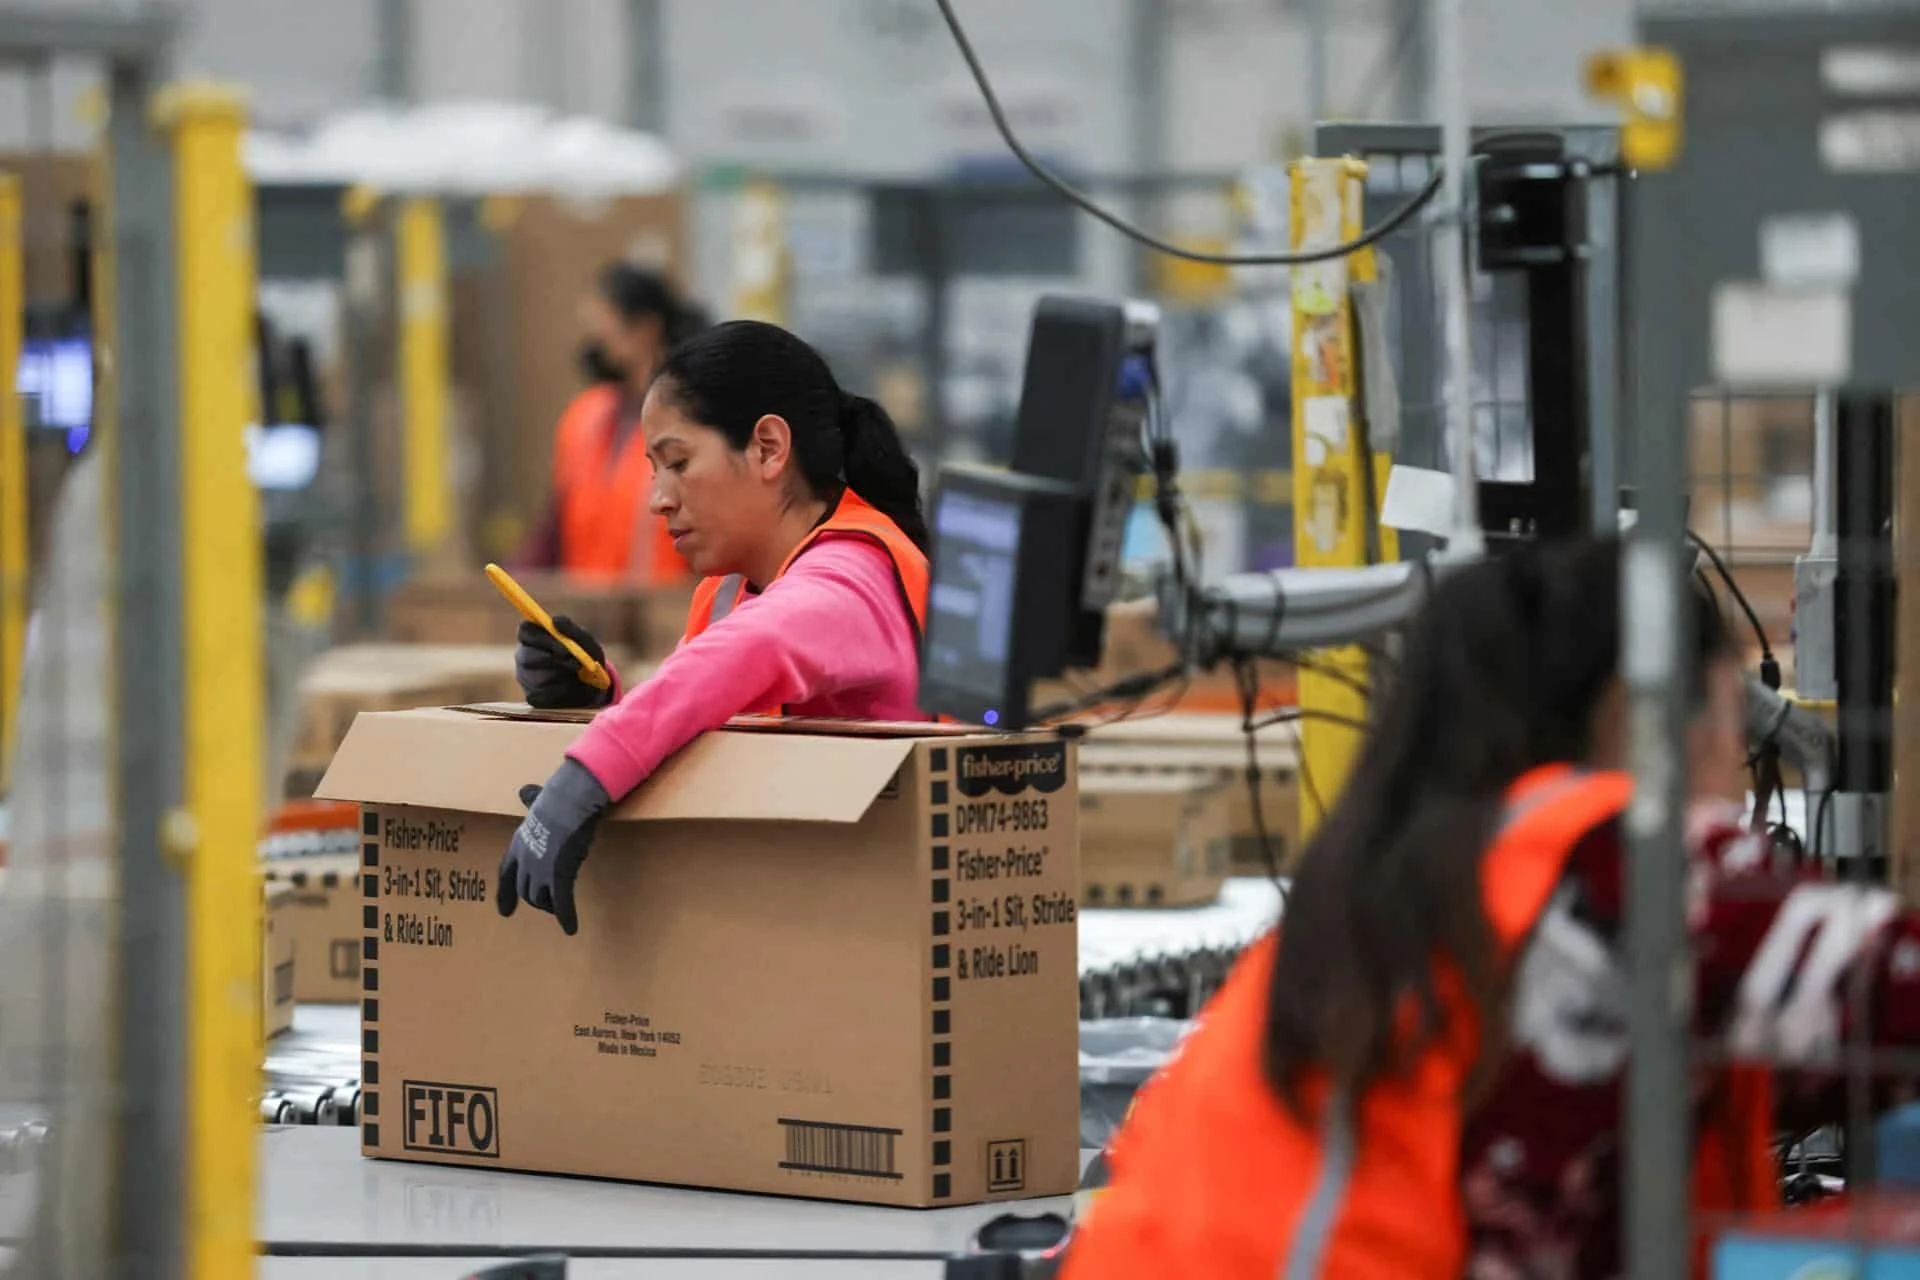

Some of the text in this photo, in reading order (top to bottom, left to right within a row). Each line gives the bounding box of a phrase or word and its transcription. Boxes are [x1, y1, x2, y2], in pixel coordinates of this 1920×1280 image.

[963, 752, 1061, 782] fisher-price
[956, 799, 1049, 835] DPM74-9863
[384, 865, 486, 905] 3-in-1 Sit, Stride
[957, 890, 1075, 933] 3-in-1 Sit, Stride
[384, 912, 453, 948] & Ride Lion
[958, 943, 1038, 979] & Ride Lion
[408, 1087, 493, 1151] FIFO
